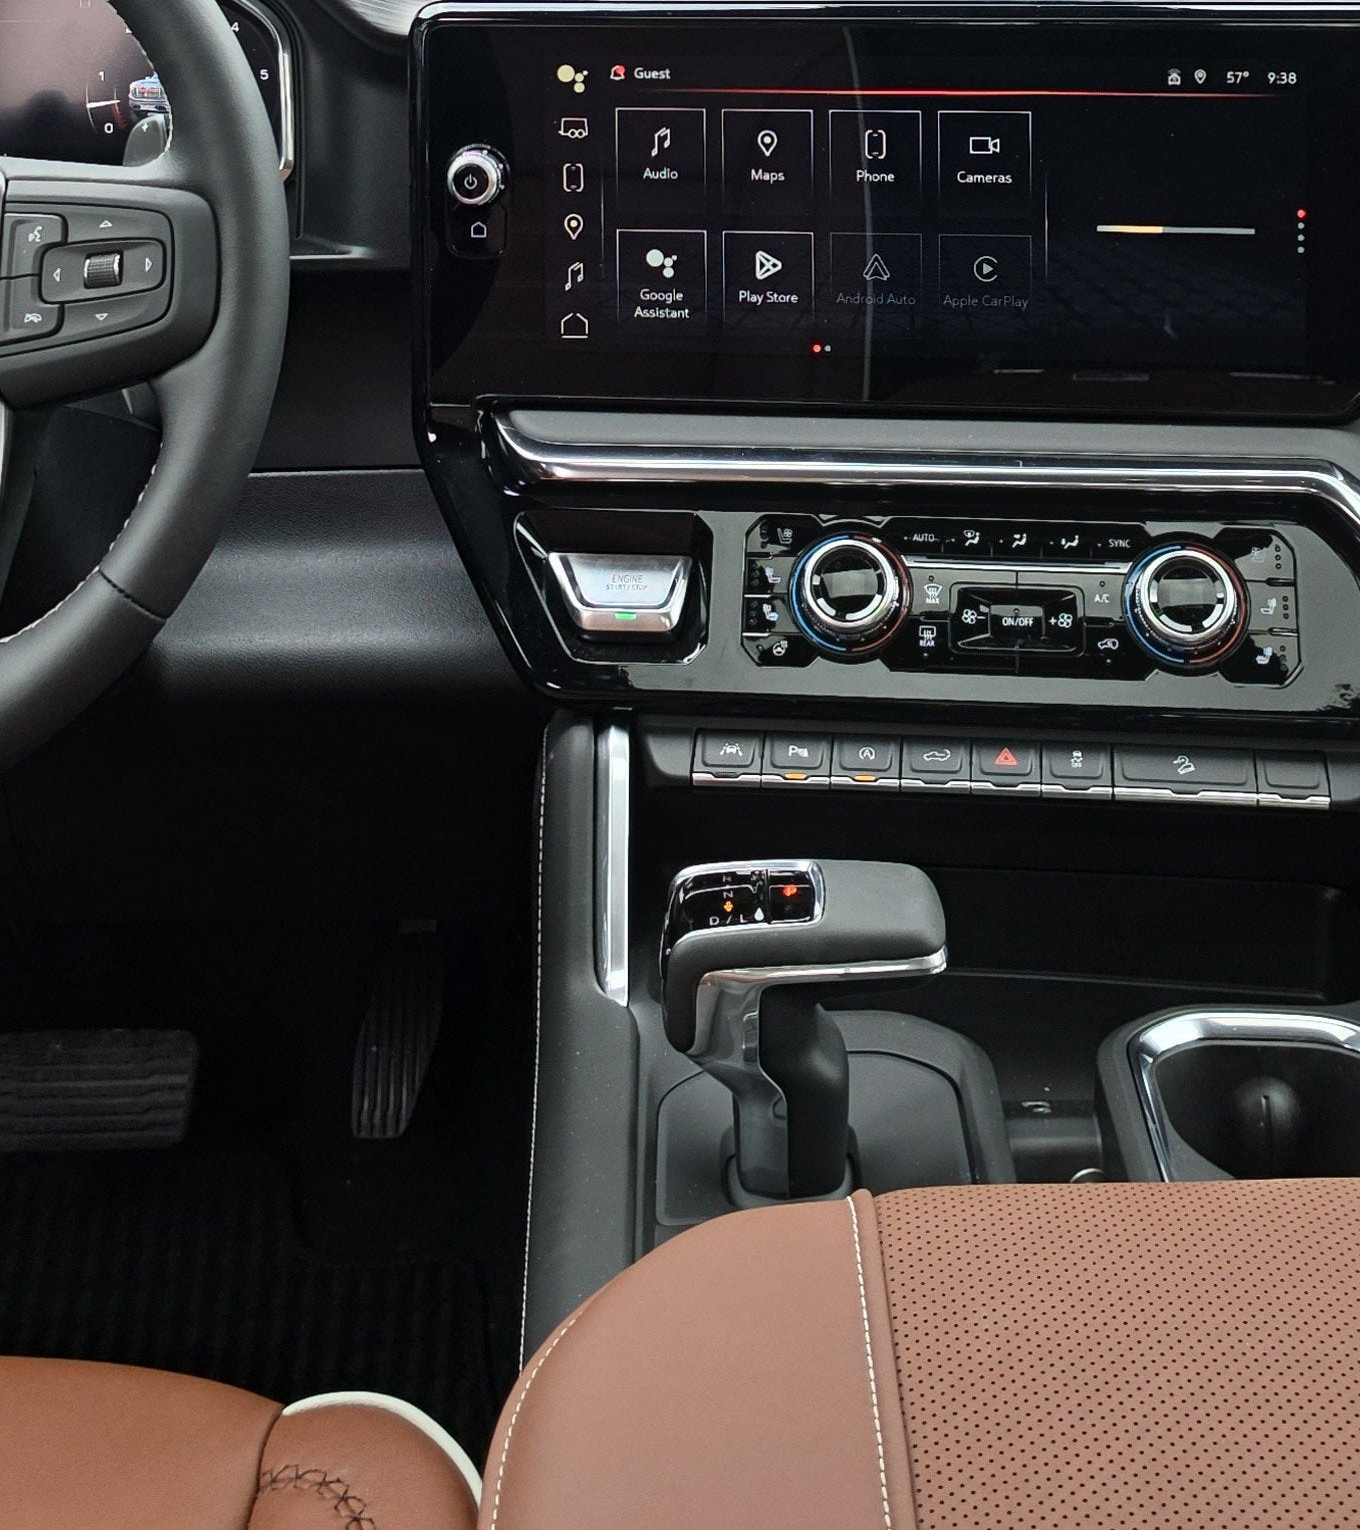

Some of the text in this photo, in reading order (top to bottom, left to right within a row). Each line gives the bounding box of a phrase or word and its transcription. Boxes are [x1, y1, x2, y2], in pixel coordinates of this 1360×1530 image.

[230, 22, 240, 32] 4
[98, 71, 105, 82] 1
[259, 69, 269, 80] 5
[633, 66, 671, 80] Guest
[1226, 70, 1297, 85] 57° 9:38
[104, 123, 114, 134] 0
[642, 167, 678, 181] Audio
[751, 169, 785, 183] Maps
[856, 169, 895, 183] Phone
[956, 170, 1013, 184] Cameras
[640, 288, 683, 304] Google
[739, 290, 799, 305] Play Store
[836, 292, 916, 306] Android Auto
[943, 293, 1029, 310] Apple CarPlay
[634, 305, 690, 319] Assistant
[912, 533, 935, 542] AUTO
[1108, 539, 1131, 548] SYNC
[612, 574, 644, 583] ENGINE
[1094, 594, 1110, 604] A/C
[1001, 617, 1034, 627] ON/OFF
[919, 639, 935, 647] REAR
[709, 916, 720, 926] D
